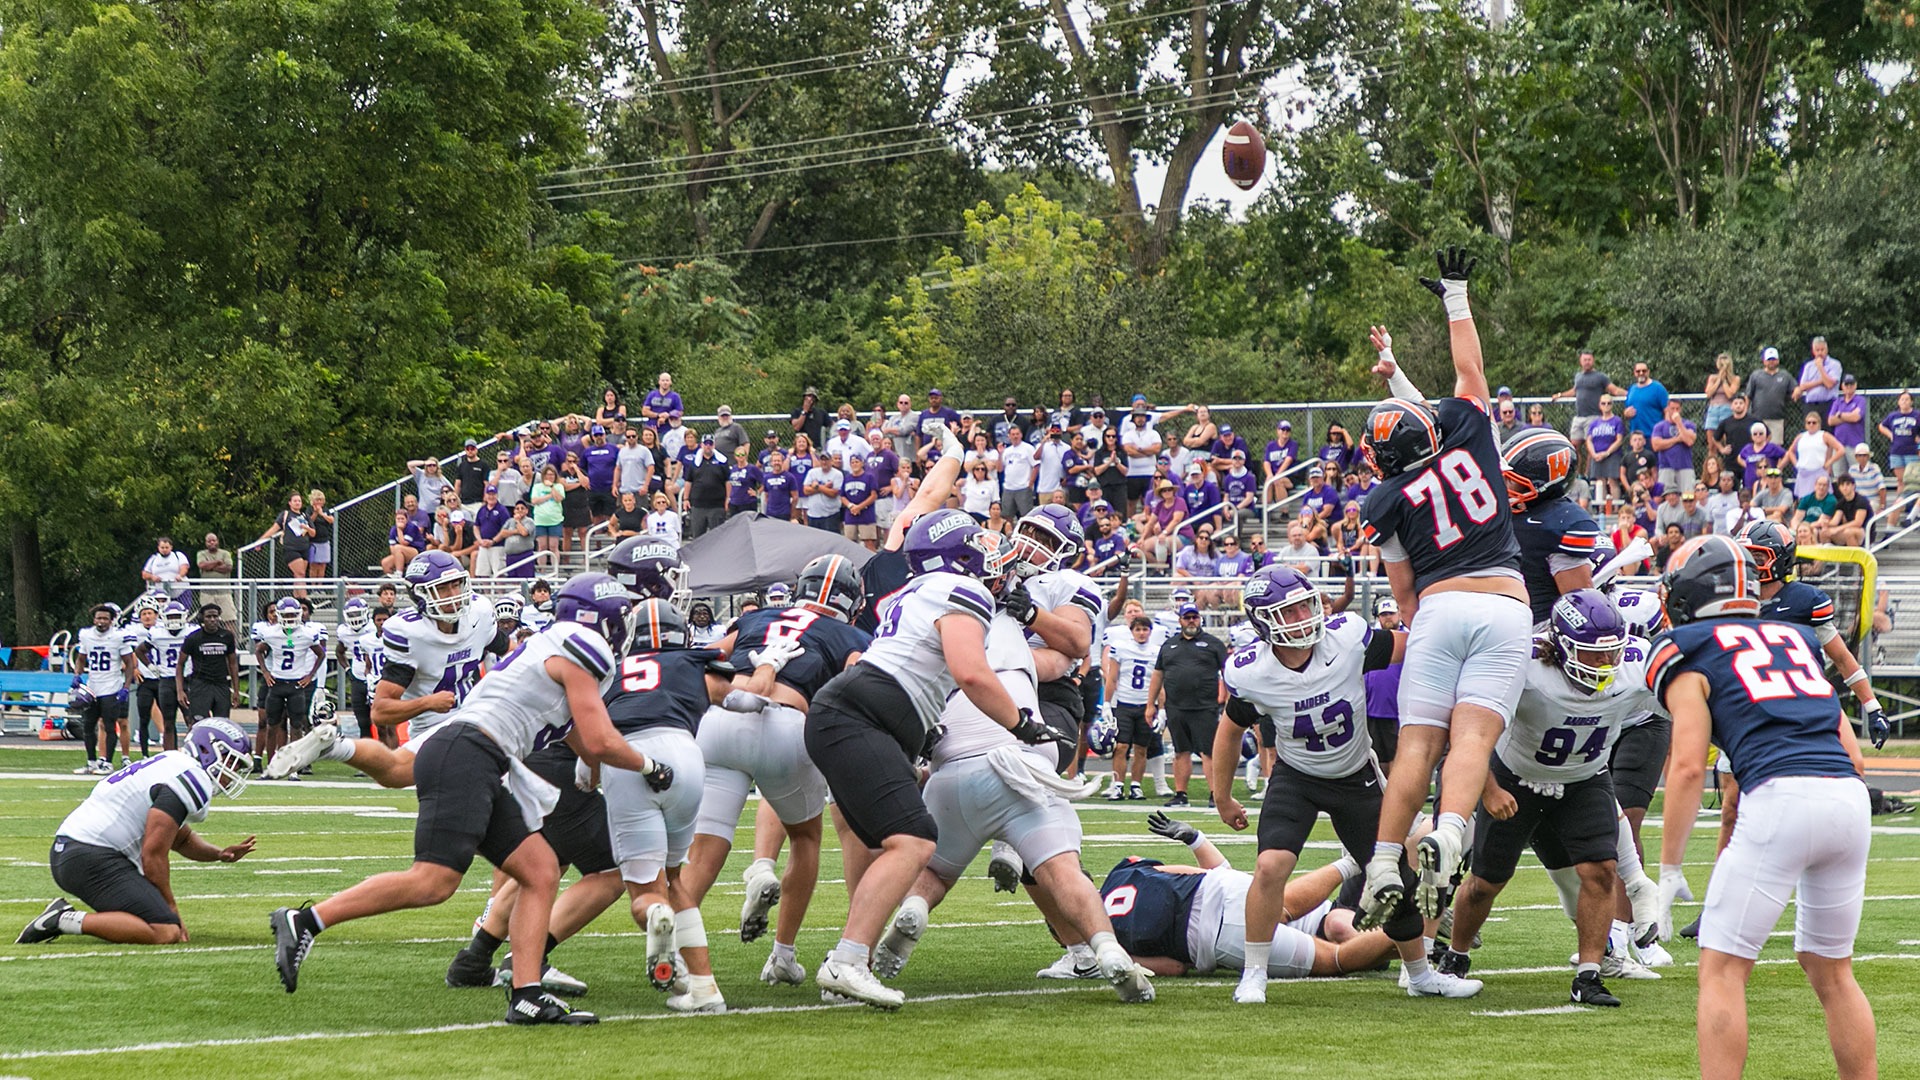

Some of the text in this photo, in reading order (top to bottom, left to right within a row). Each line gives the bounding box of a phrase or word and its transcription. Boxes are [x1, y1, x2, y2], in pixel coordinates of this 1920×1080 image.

[1547, 447, 1570, 481] W
[1402, 448, 1498, 551] 78
[928, 513, 972, 542] RAIDERS
[632, 544, 677, 561] RAIDERS
[89, 651, 111, 671] 26
[281, 650, 294, 670] 2
[447, 649, 472, 663] RAIDERS
[1713, 622, 1835, 703] 23
[622, 652, 661, 693] 5
[1131, 665, 1146, 689] 8
[1294, 692, 1330, 712] RAIDERS
[1293, 699, 1354, 751] 43
[1563, 716, 1602, 726] RAIDERS
[1535, 726, 1610, 766] 94
[515, 999, 540, 1018] NIKE
